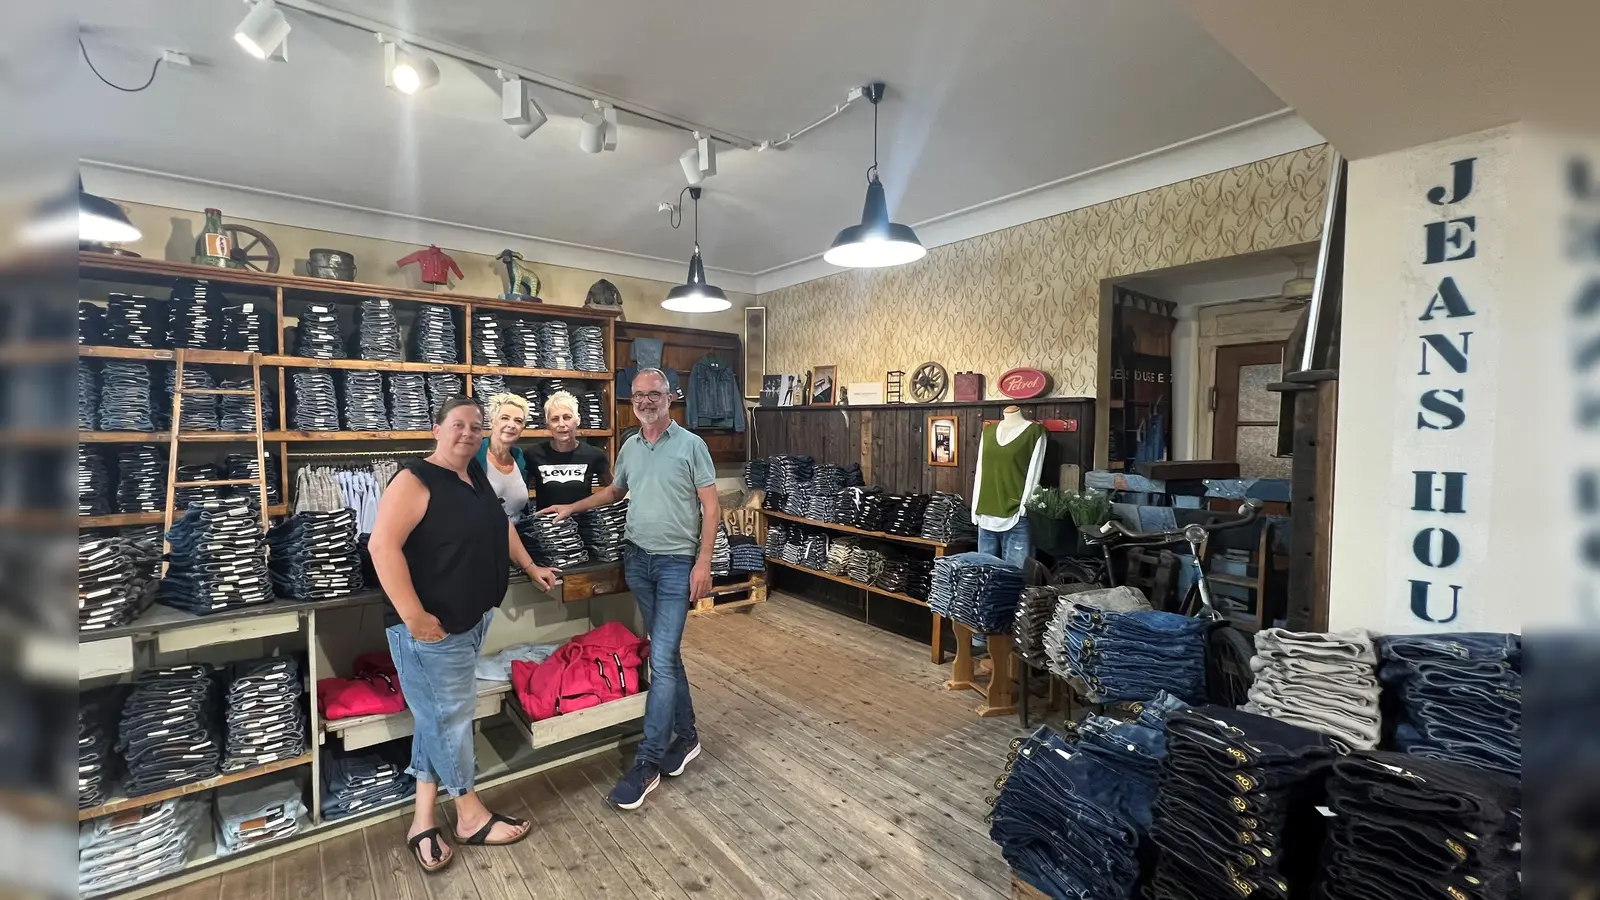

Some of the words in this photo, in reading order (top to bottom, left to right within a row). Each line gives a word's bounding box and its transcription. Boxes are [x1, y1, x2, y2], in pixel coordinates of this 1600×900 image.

[1416, 157, 1478, 430] JEANS
[1002, 375, 1039, 391] Petrol
[1407, 470, 1468, 623] HOU
